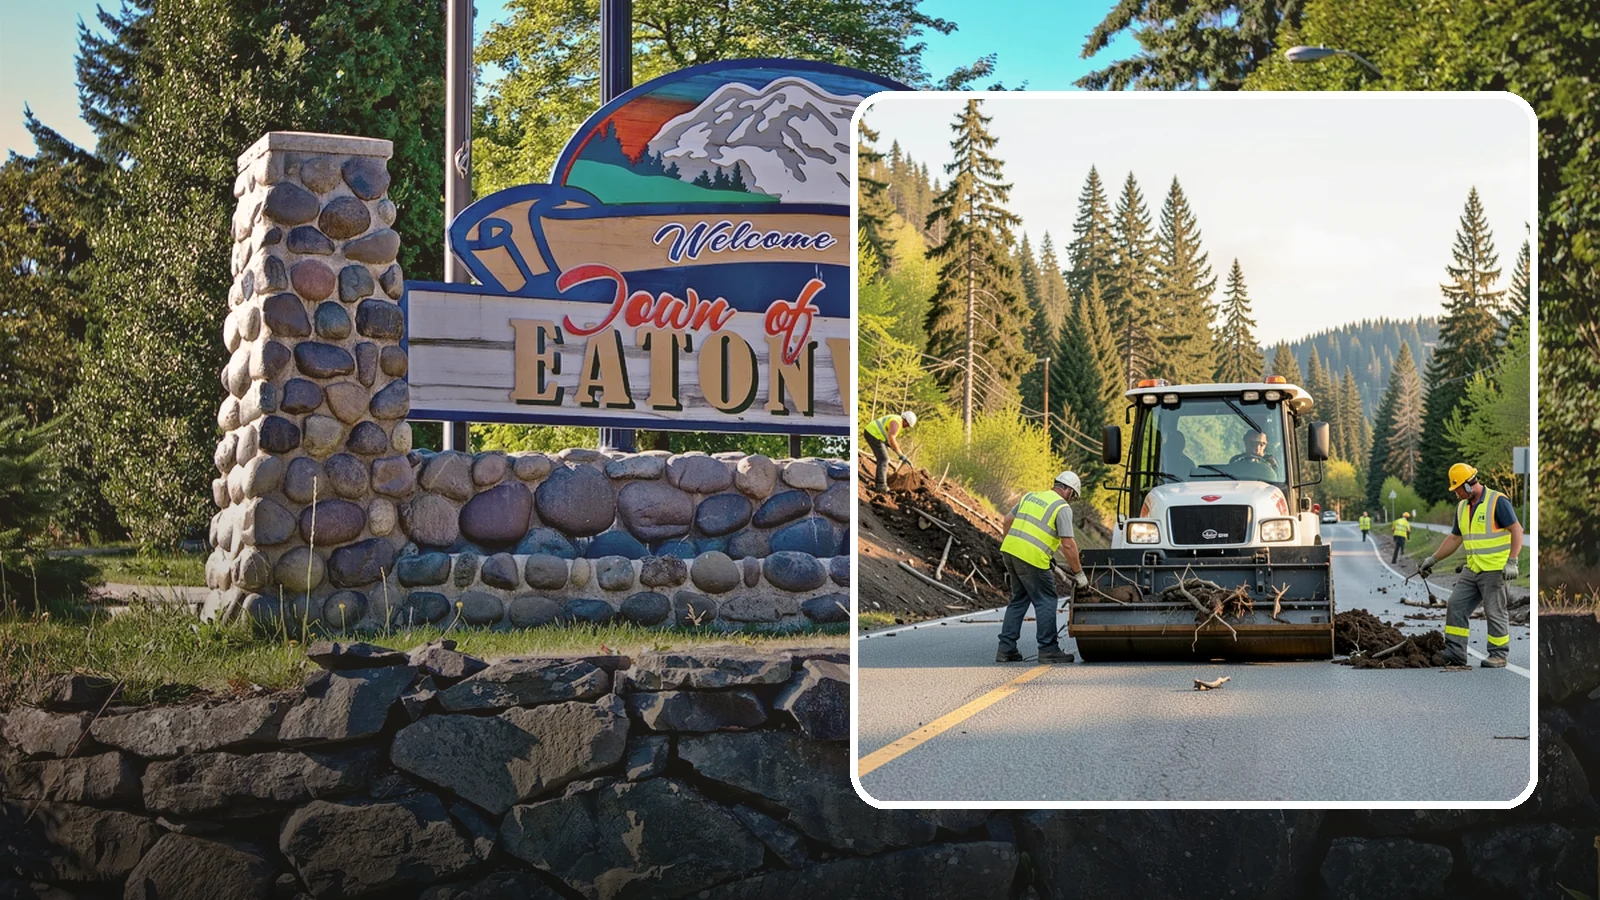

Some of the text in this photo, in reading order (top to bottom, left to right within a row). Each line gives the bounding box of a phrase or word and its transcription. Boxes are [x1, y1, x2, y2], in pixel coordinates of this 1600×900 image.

[655, 222, 836, 263] Welcome
[557, 264, 826, 365] Town of
